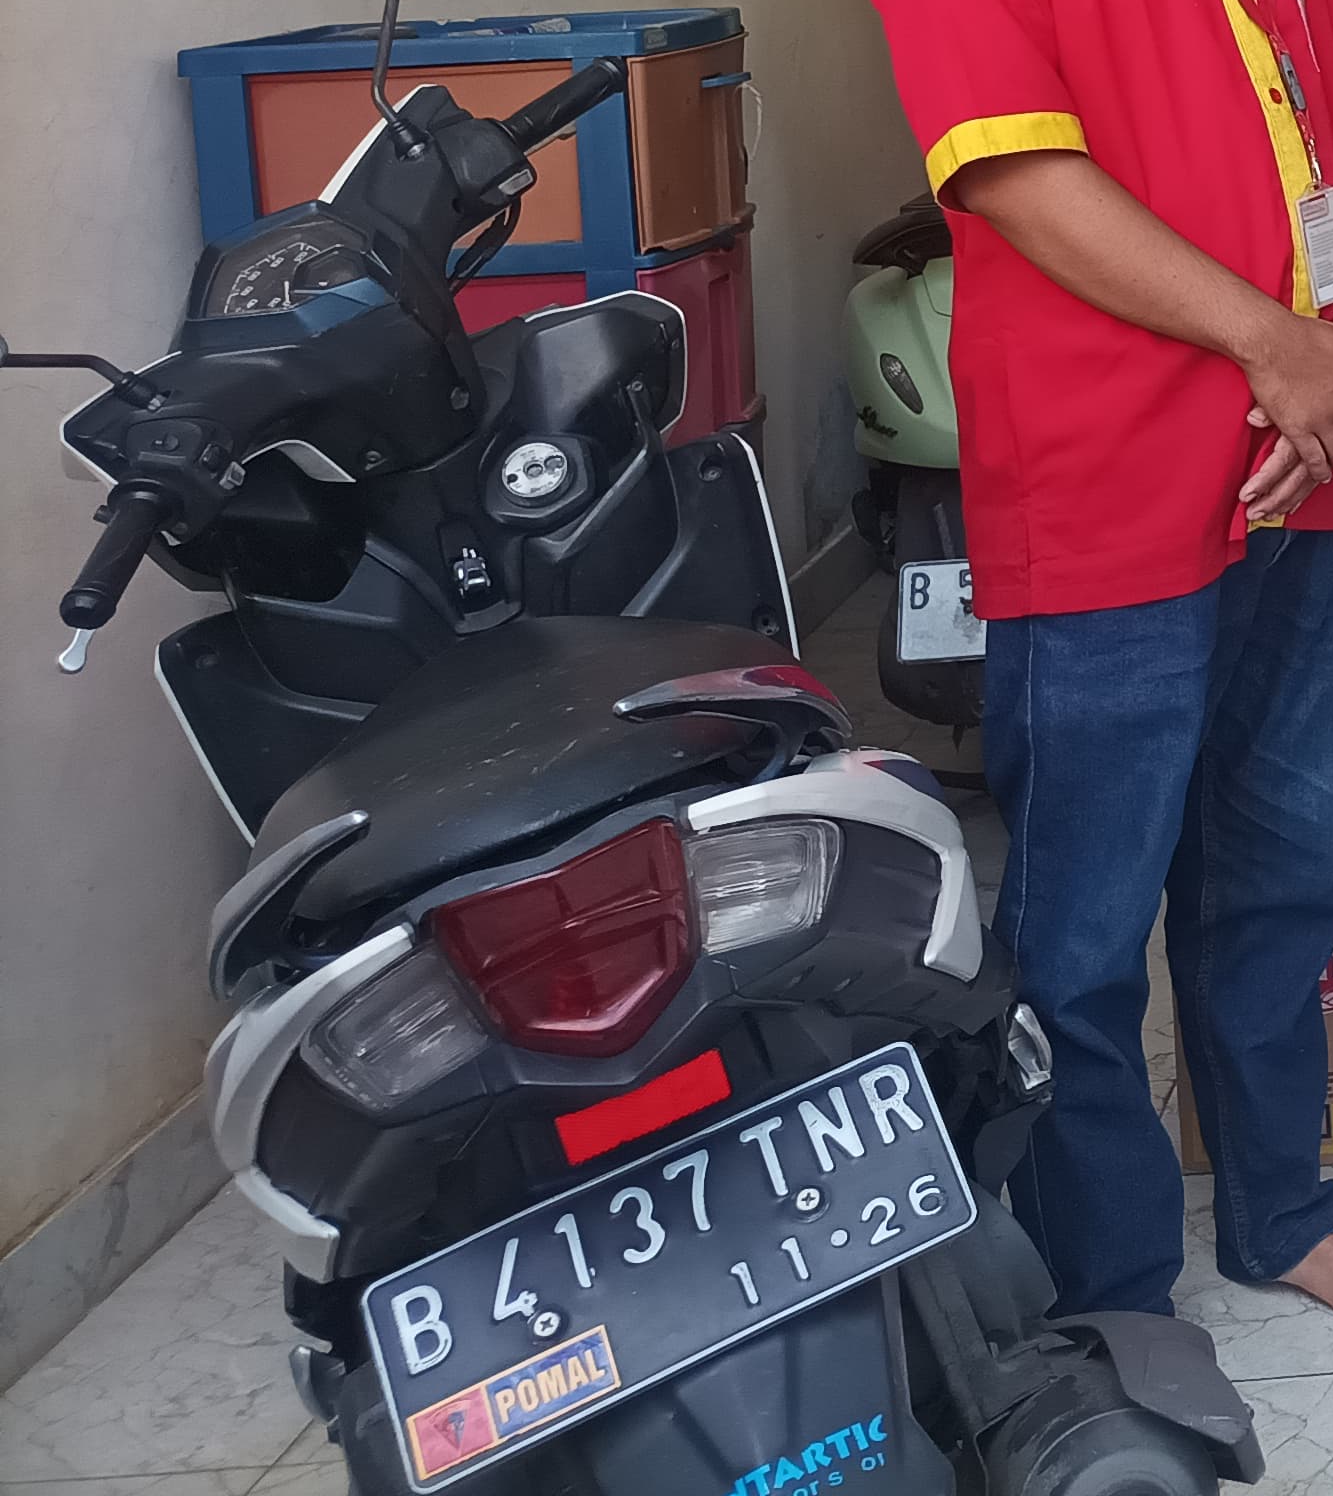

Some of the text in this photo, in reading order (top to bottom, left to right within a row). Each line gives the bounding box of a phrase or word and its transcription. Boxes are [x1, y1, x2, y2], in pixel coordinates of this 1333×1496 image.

[909, 572, 931, 610] B
[391, 1064, 924, 1377] B 4137 TNR
[495, 1348, 606, 1425] POMAL
